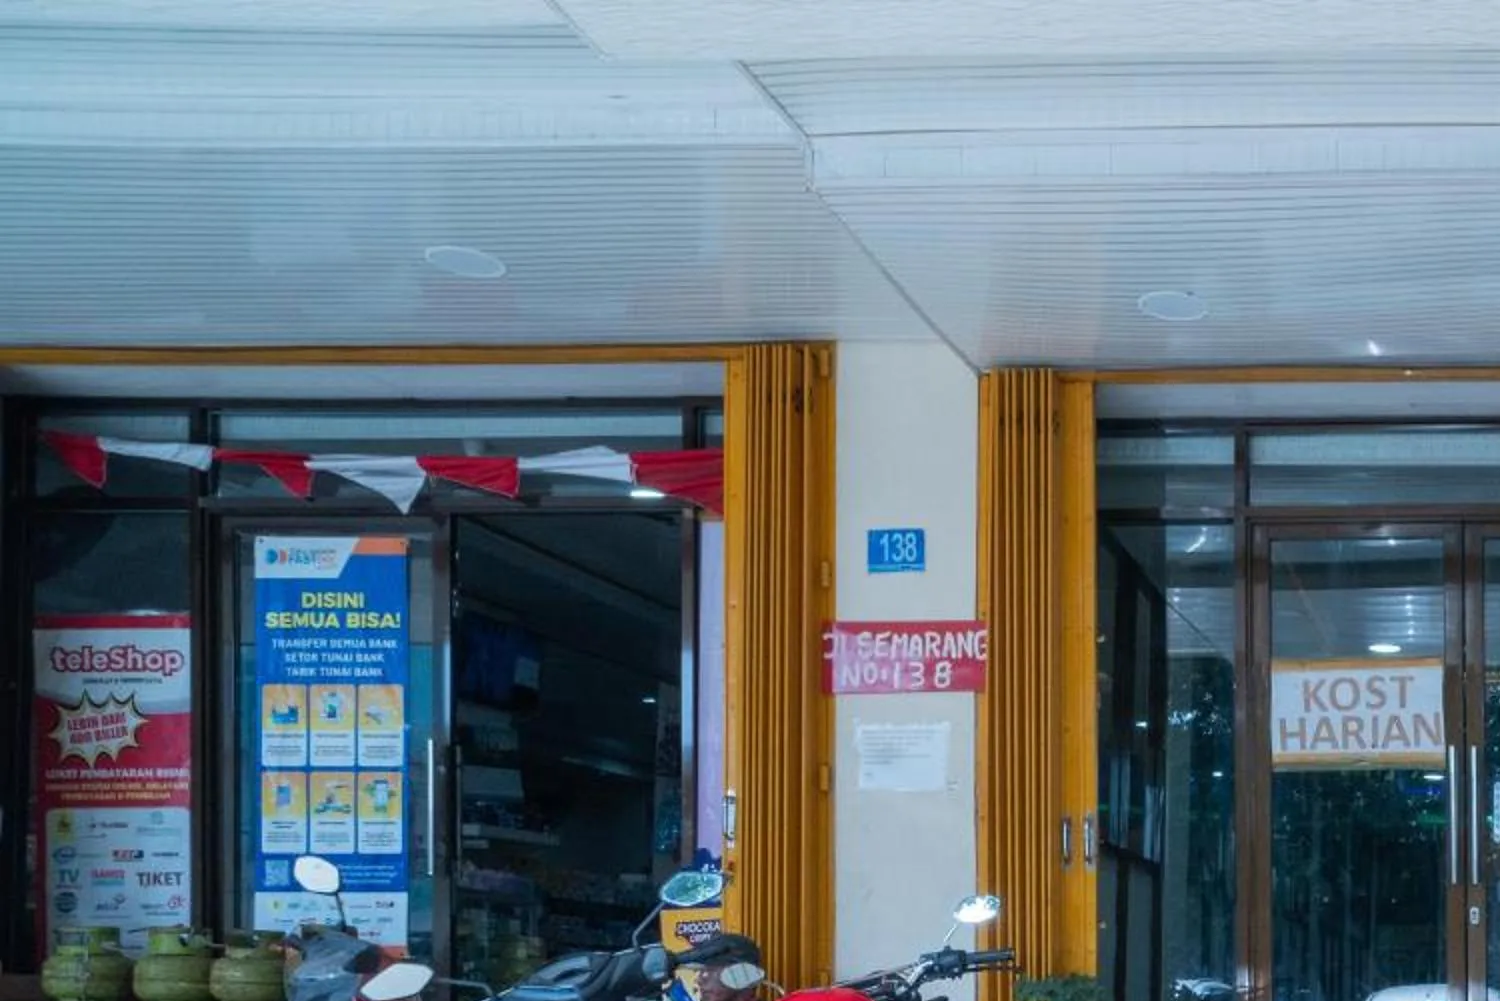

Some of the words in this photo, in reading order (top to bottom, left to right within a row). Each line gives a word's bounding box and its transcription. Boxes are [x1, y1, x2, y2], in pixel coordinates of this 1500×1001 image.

[880, 533, 917, 562] 138
[301, 591, 365, 608] DISINI
[265, 612, 340, 629] SEMUA
[346, 612, 401, 629] BISA!
[272, 638, 327, 649] TRANSFER
[330, 638, 366, 649] SEMUA
[368, 638, 398, 649] BANK
[51, 644, 184, 675] teleShop
[285, 653, 318, 664] SETOR
[322, 653, 353, 664] TUNAI
[356, 653, 384, 664] BANK
[320, 667, 352, 678] TUNAI
[354, 667, 383, 678] BANK
[1302, 675, 1416, 713] KOST
[1279, 712, 1443, 751] HARIAN
[58, 869, 80, 883] TV
[136, 871, 182, 887] TIKET
